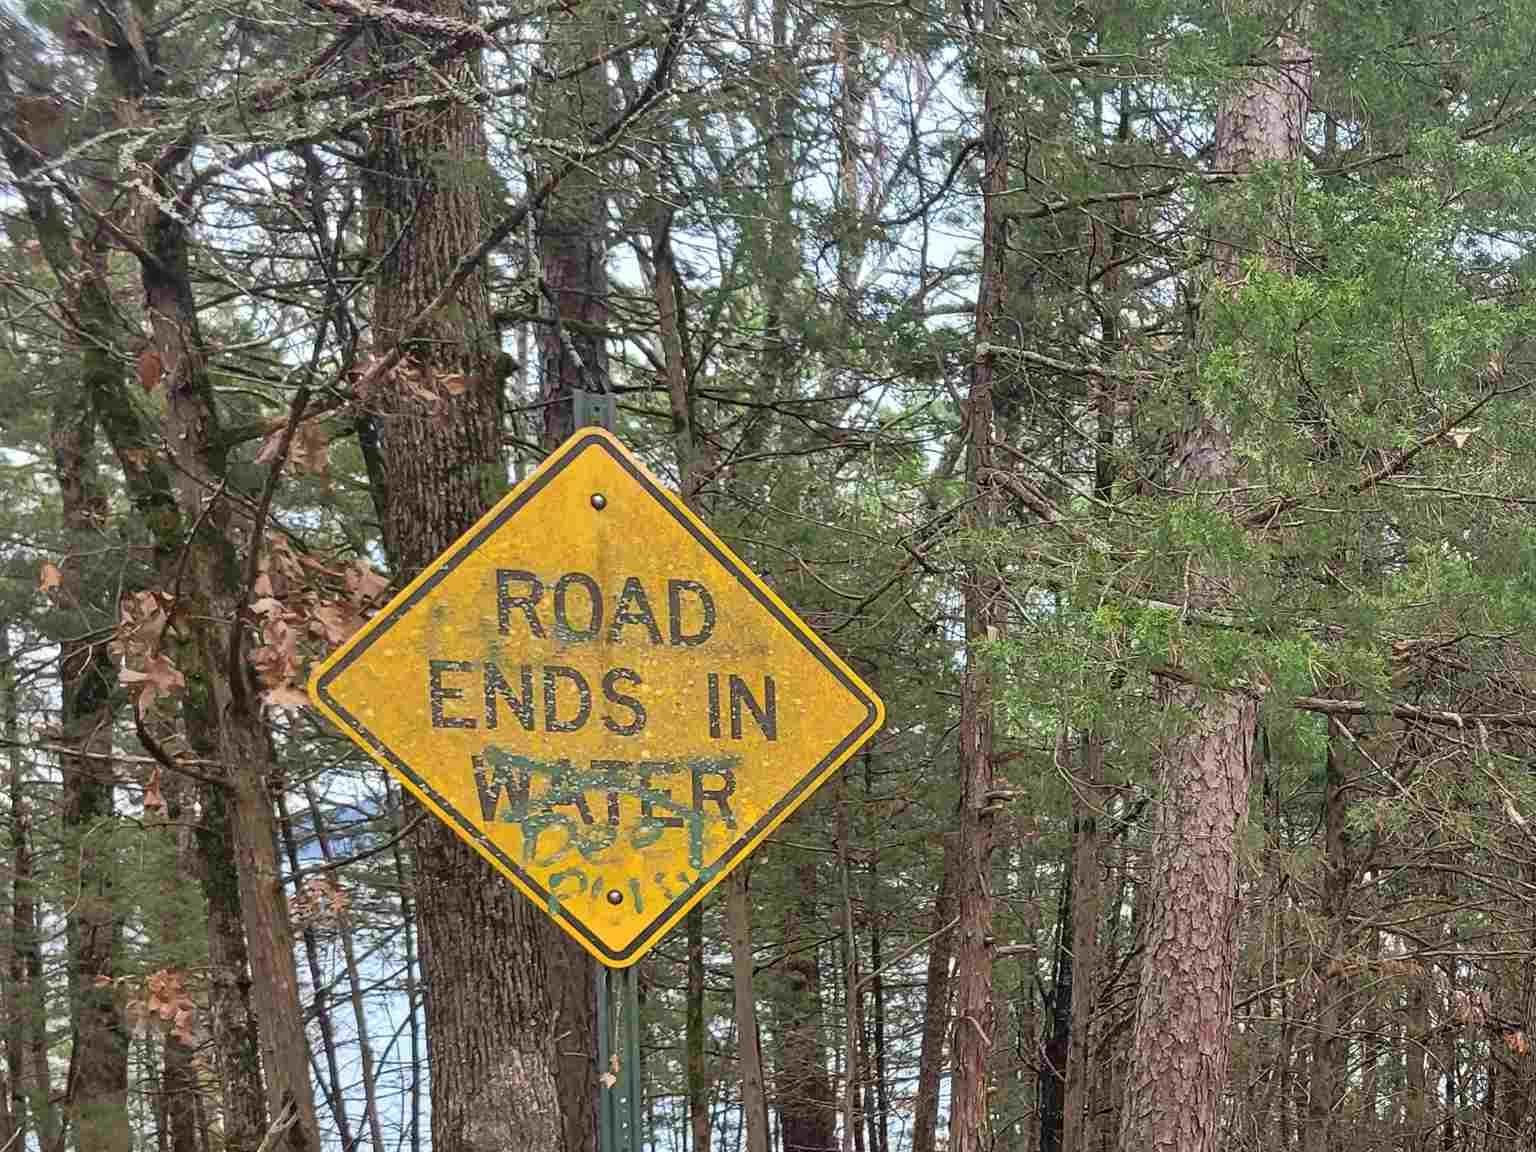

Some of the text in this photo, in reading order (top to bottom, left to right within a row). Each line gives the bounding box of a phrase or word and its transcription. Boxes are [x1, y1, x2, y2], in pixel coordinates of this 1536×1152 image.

[495, 568, 717, 646] ROAD
[429, 659, 778, 741] ENDS IN
[471, 753, 738, 829] WATER
